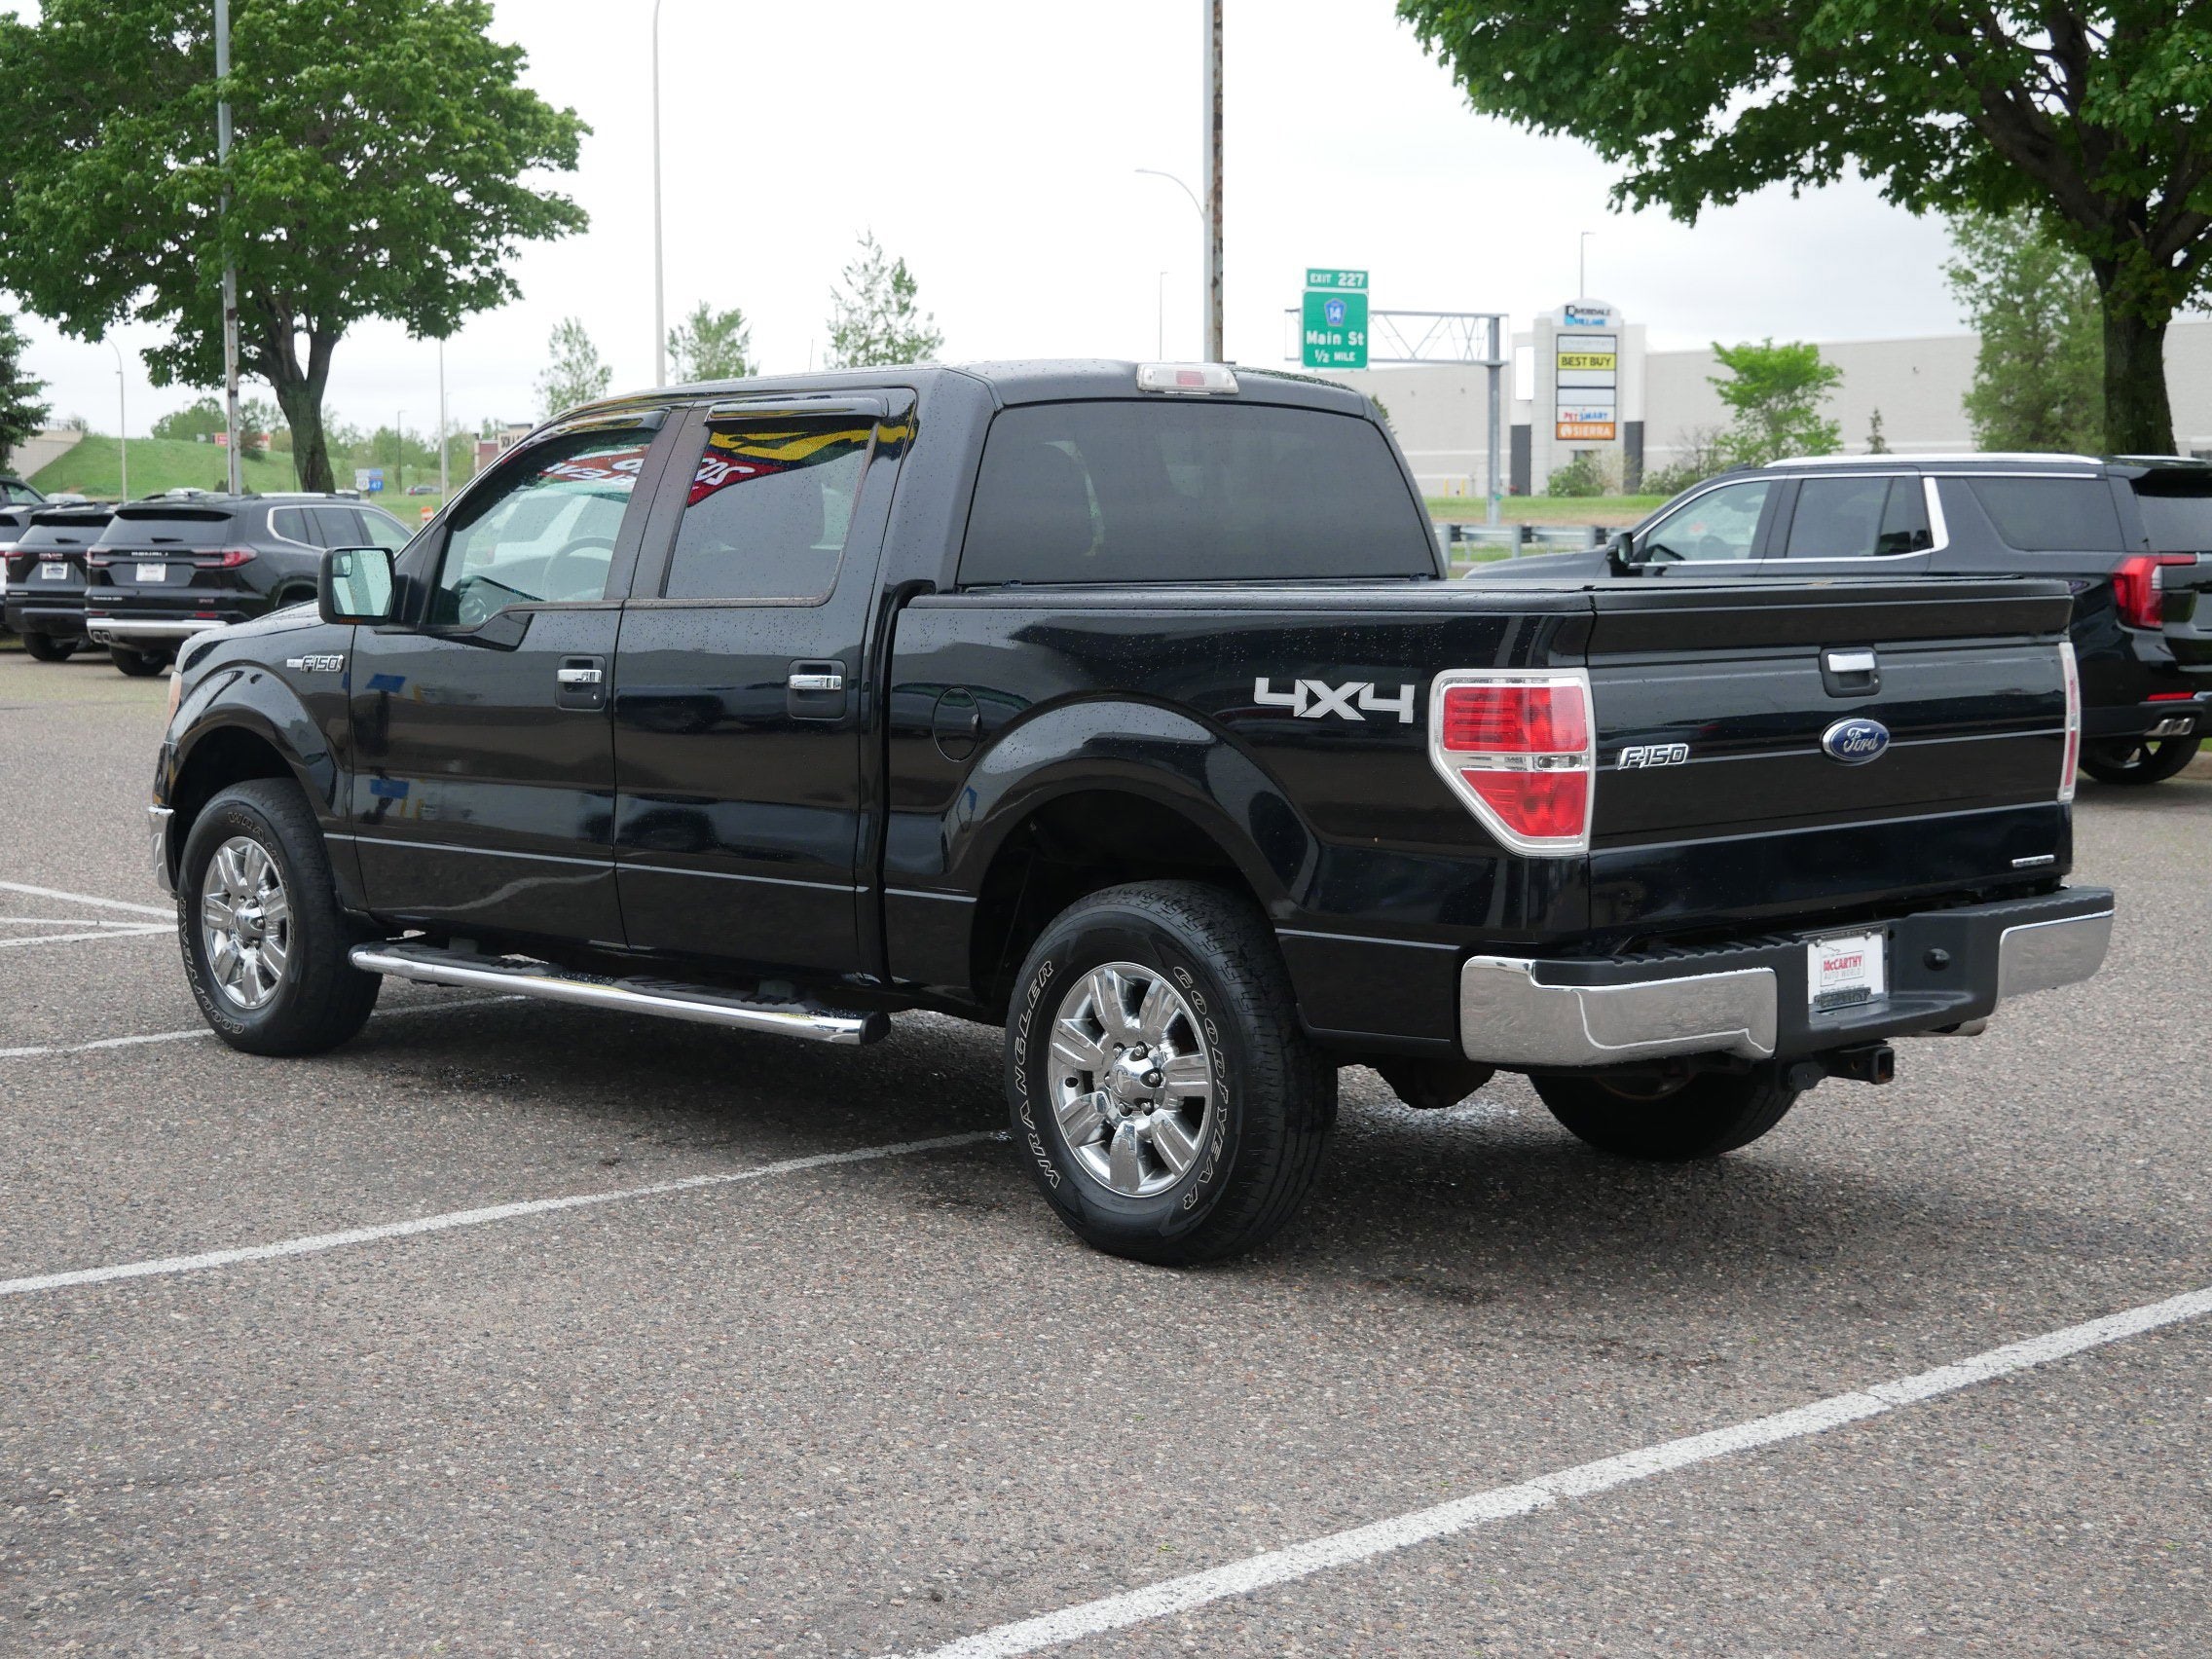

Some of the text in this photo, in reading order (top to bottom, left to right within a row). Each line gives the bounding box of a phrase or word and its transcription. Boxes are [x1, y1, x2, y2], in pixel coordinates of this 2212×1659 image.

[1309, 272, 1365, 287] EXIT 227
[1329, 307, 1342, 320] 14
[1306, 330, 1365, 347] Main St
[1334, 351, 1356, 362] MILE
[1562, 356, 1612, 367] BEST BUY
[1572, 425, 1611, 437] SIERRA
[1843, 726, 1879, 754] Ford
[1823, 955, 1862, 973] McCARTHY
[1014, 960, 1061, 1189] WRANGLER
[1173, 966, 1229, 1210] GOODYEAR
